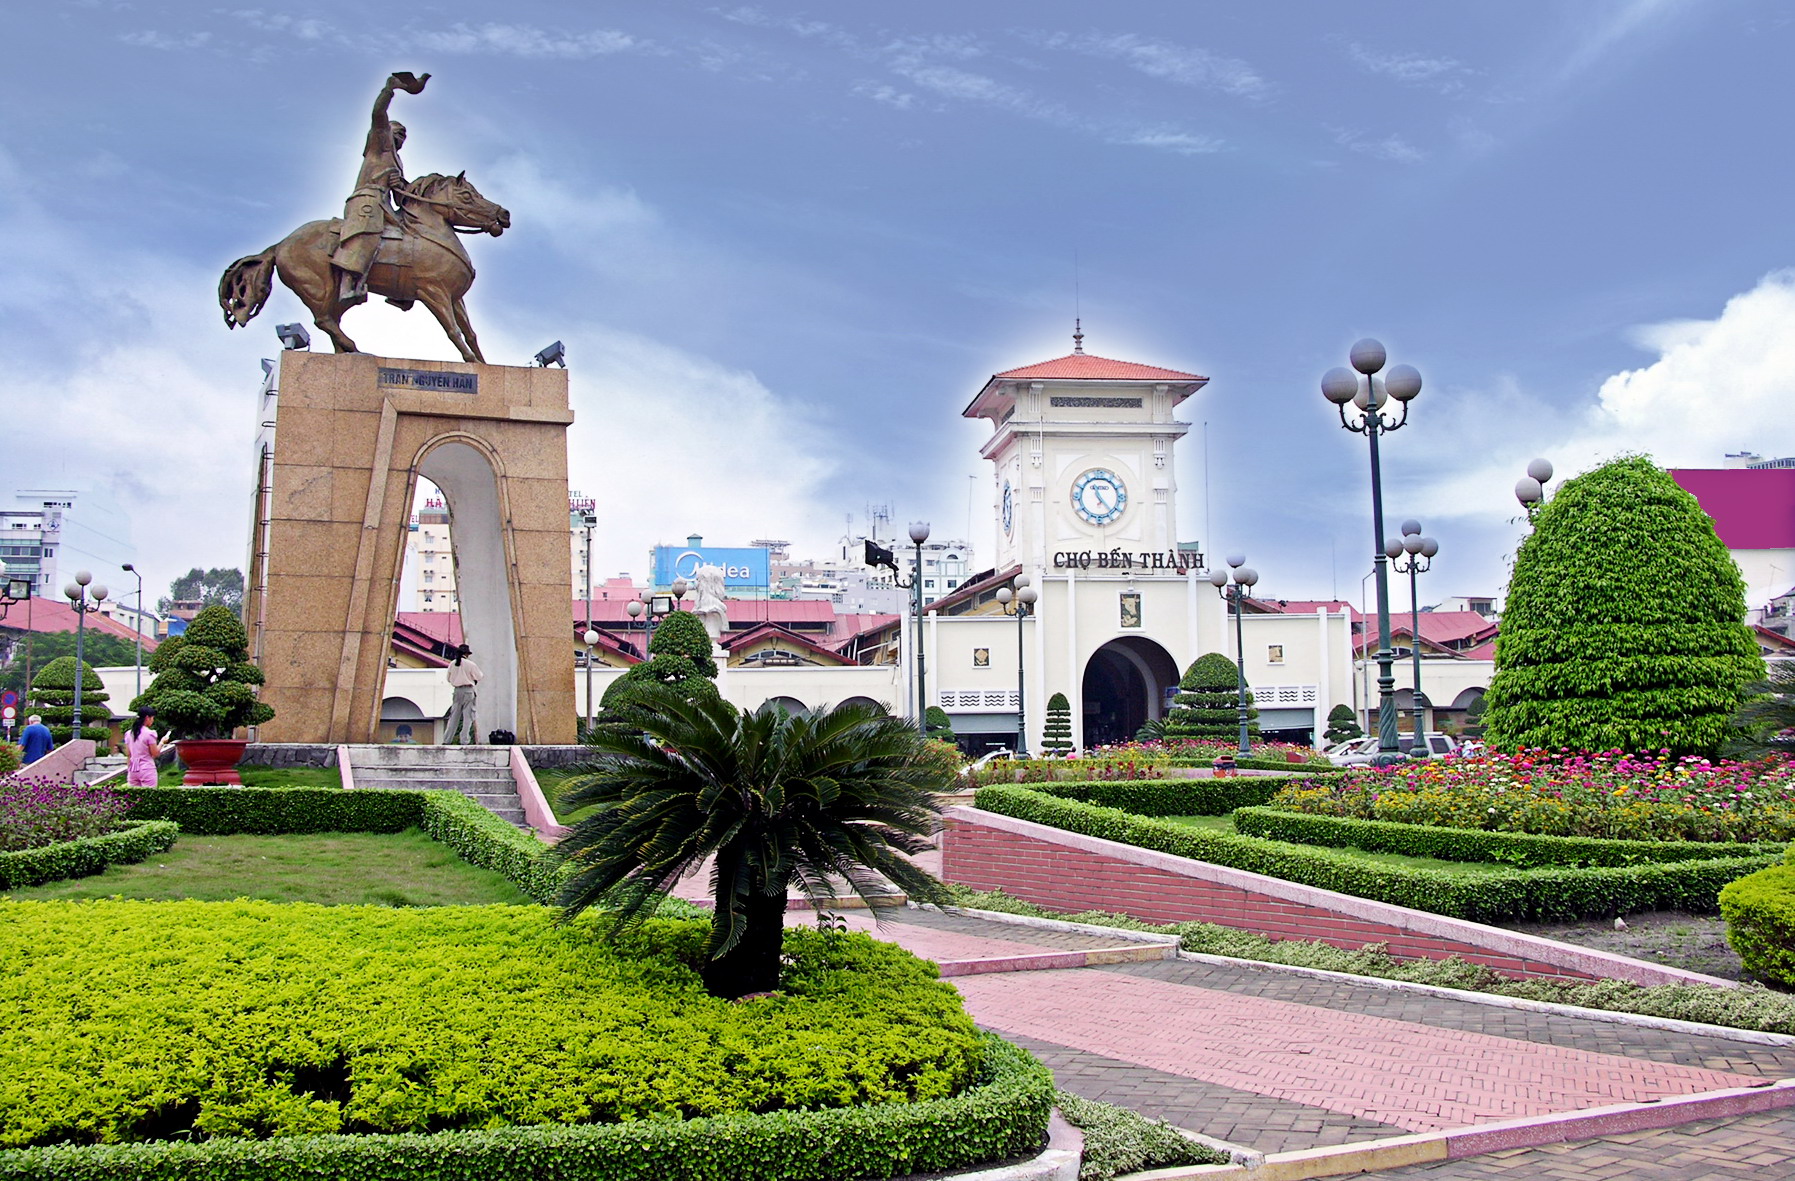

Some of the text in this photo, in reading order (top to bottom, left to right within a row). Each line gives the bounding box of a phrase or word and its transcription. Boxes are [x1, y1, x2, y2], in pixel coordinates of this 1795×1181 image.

[1054, 547, 1205, 570] CHỢ BẾN THÀNH
[688, 562, 750, 578] Mdea
